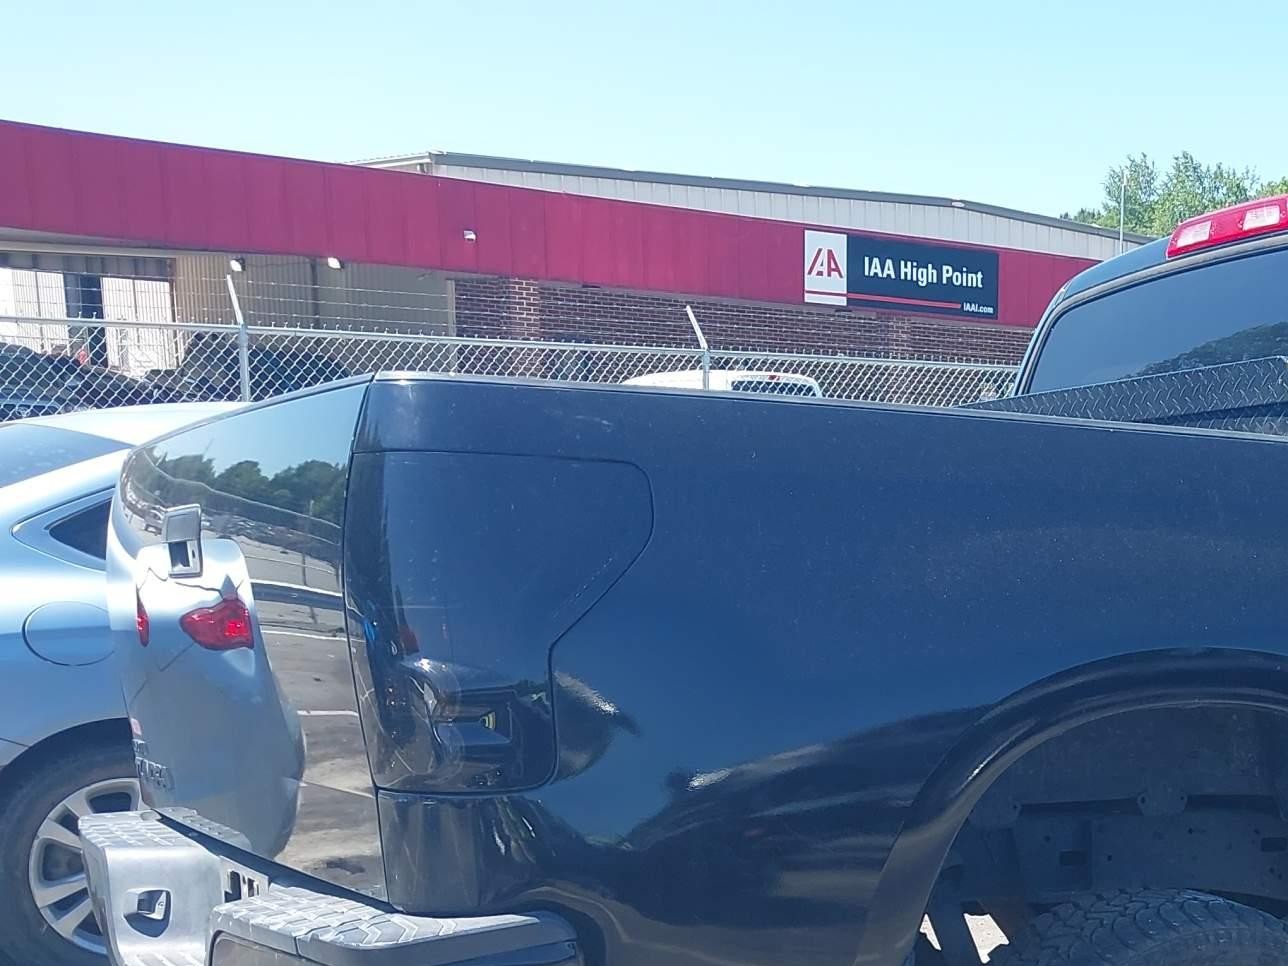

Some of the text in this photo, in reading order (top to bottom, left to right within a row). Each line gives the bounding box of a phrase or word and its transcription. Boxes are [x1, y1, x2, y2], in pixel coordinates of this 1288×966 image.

[864, 256, 983, 288] IAA High Point
[963, 301, 994, 314] IAAI.com
